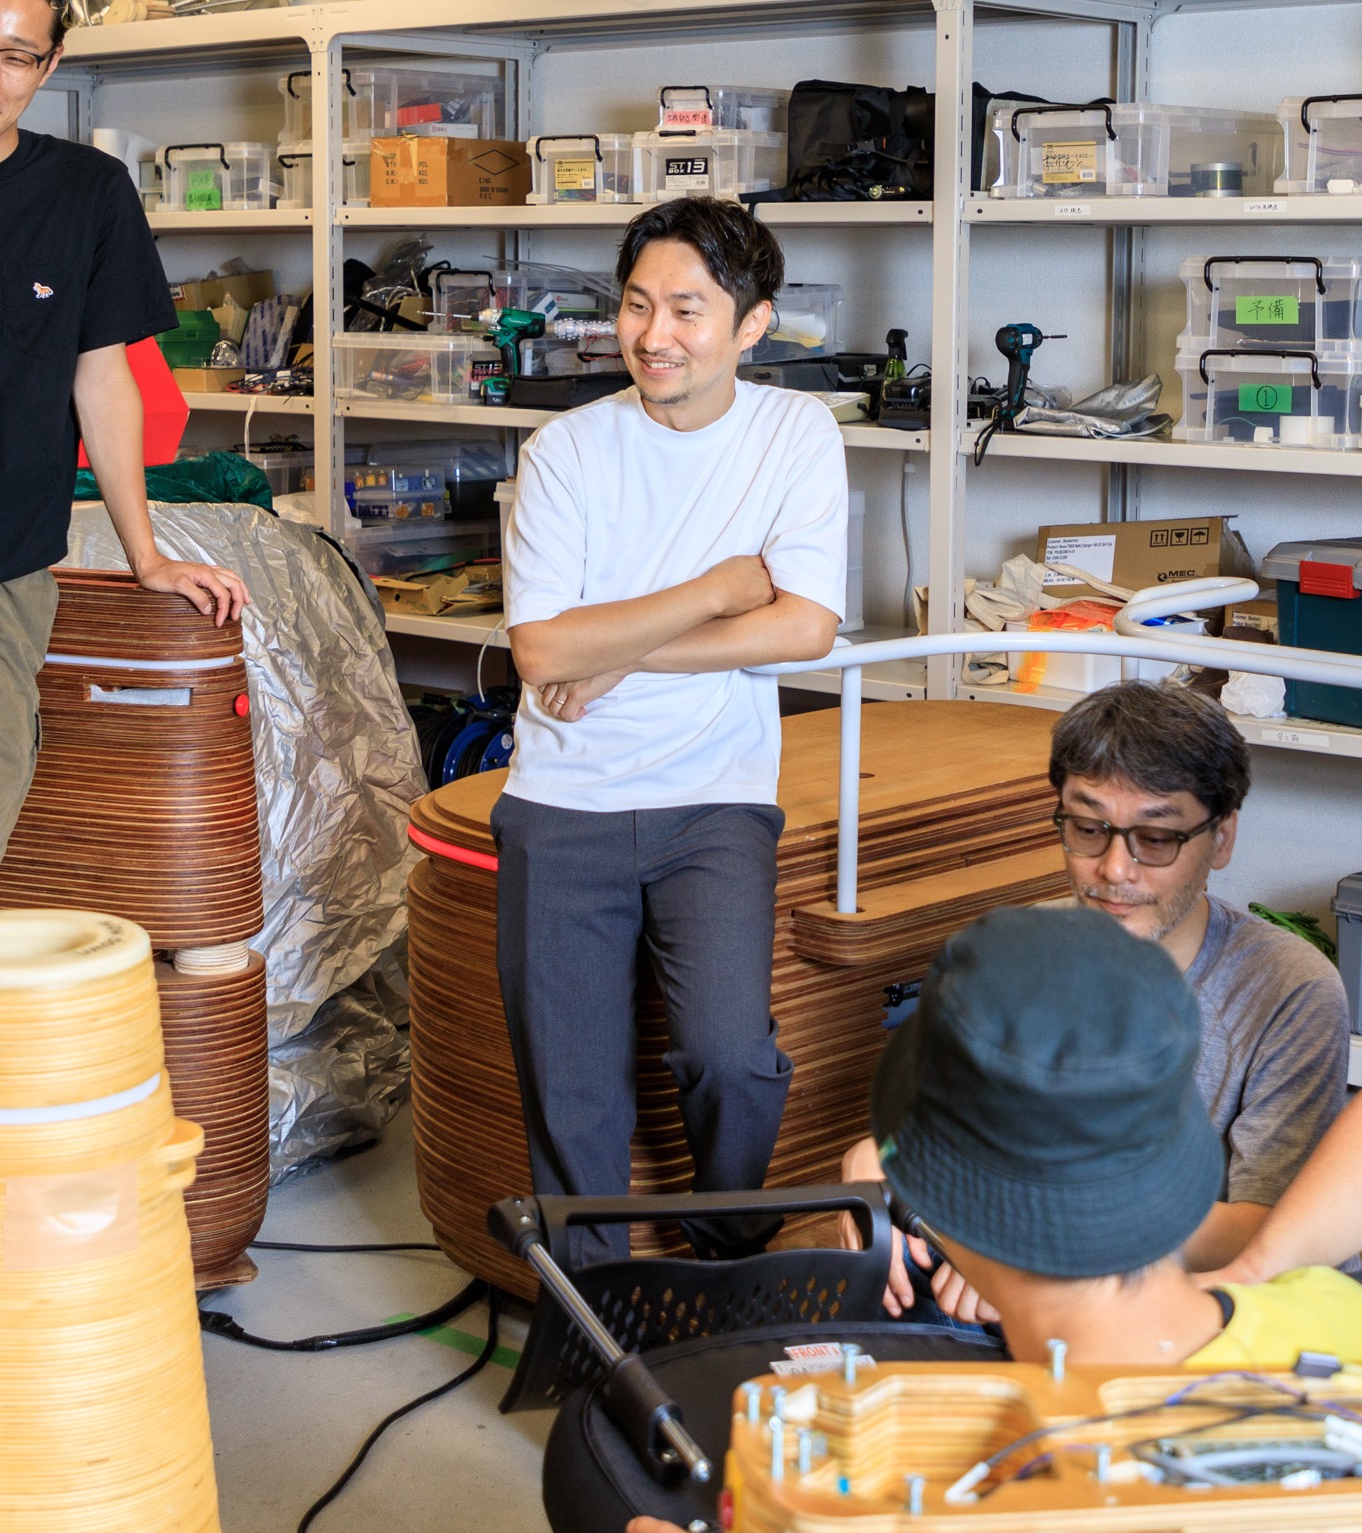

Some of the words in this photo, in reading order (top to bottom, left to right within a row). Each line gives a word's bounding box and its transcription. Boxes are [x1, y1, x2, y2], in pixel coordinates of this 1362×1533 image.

[687, 162, 705, 173] 13
[1248, 299, 1285, 320] 予備
[791, 1345, 831, 1358] FRONT
